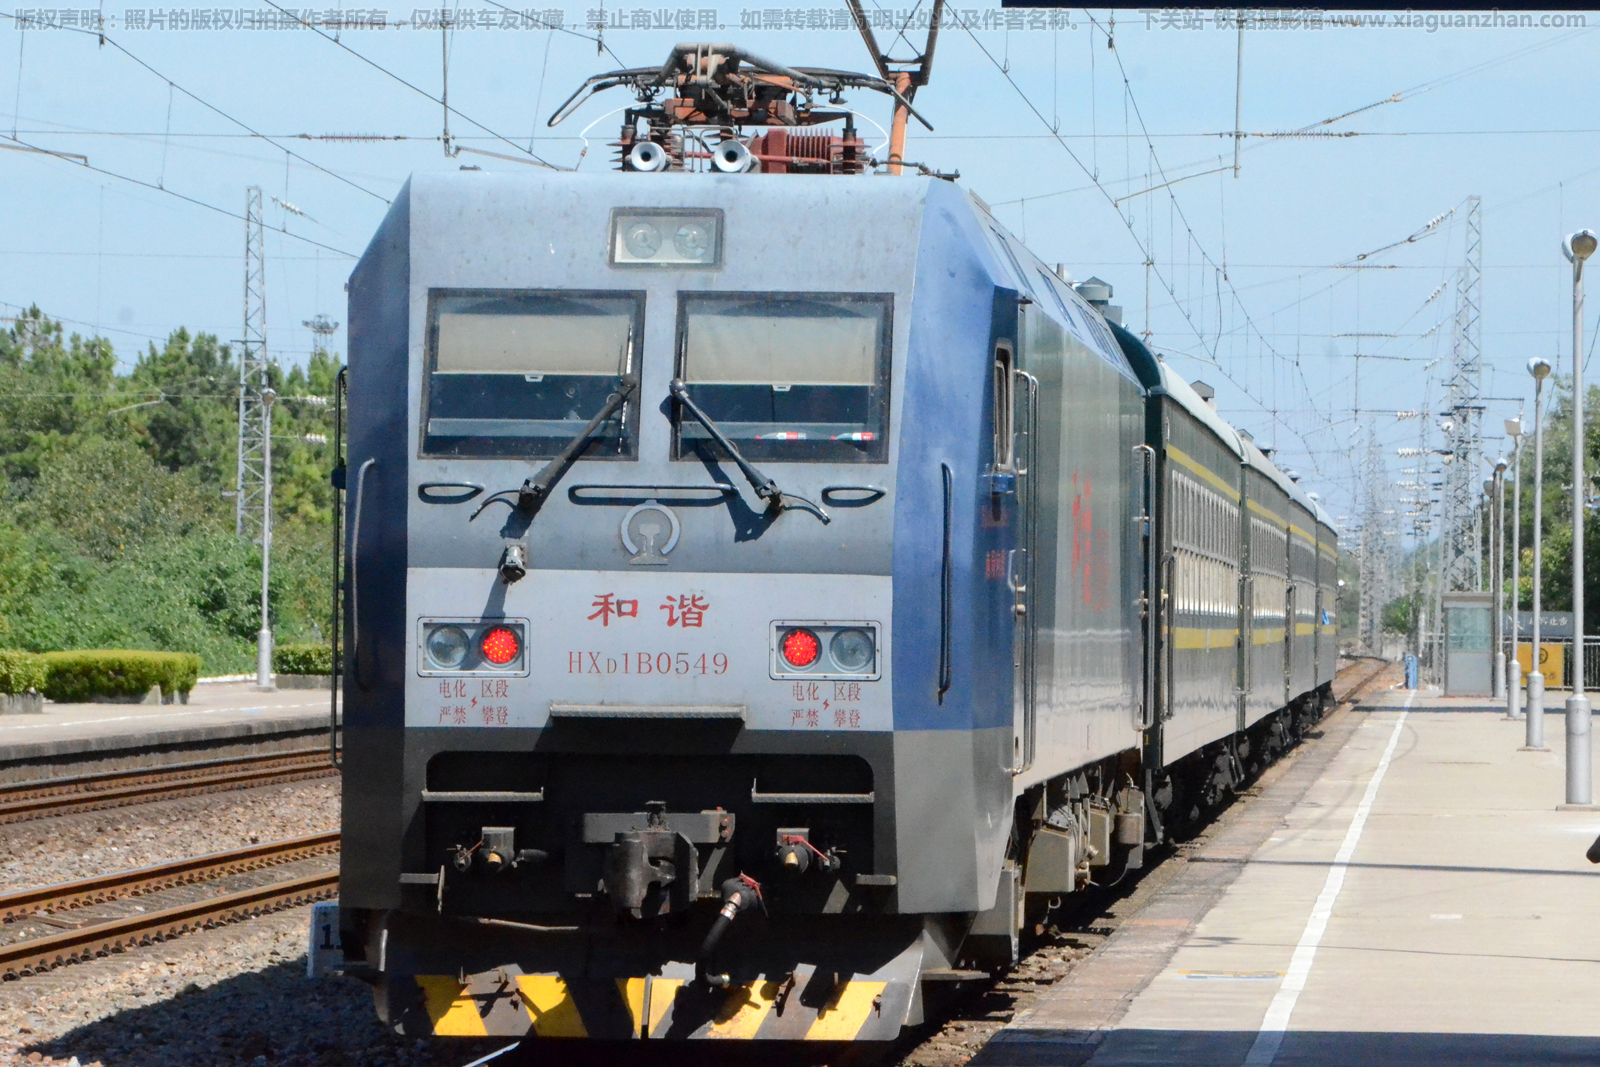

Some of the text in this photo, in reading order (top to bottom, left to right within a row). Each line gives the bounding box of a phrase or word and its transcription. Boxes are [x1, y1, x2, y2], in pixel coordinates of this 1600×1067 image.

[586, 592, 710, 628] 和谐
[567, 650, 729, 675] HXD1B0549
[439, 679, 509, 699] 电化 区段
[792, 681, 861, 701] 电化 区段
[438, 705, 509, 725] 严禁 攀登
[791, 708, 861, 728] 严禁 攀登
